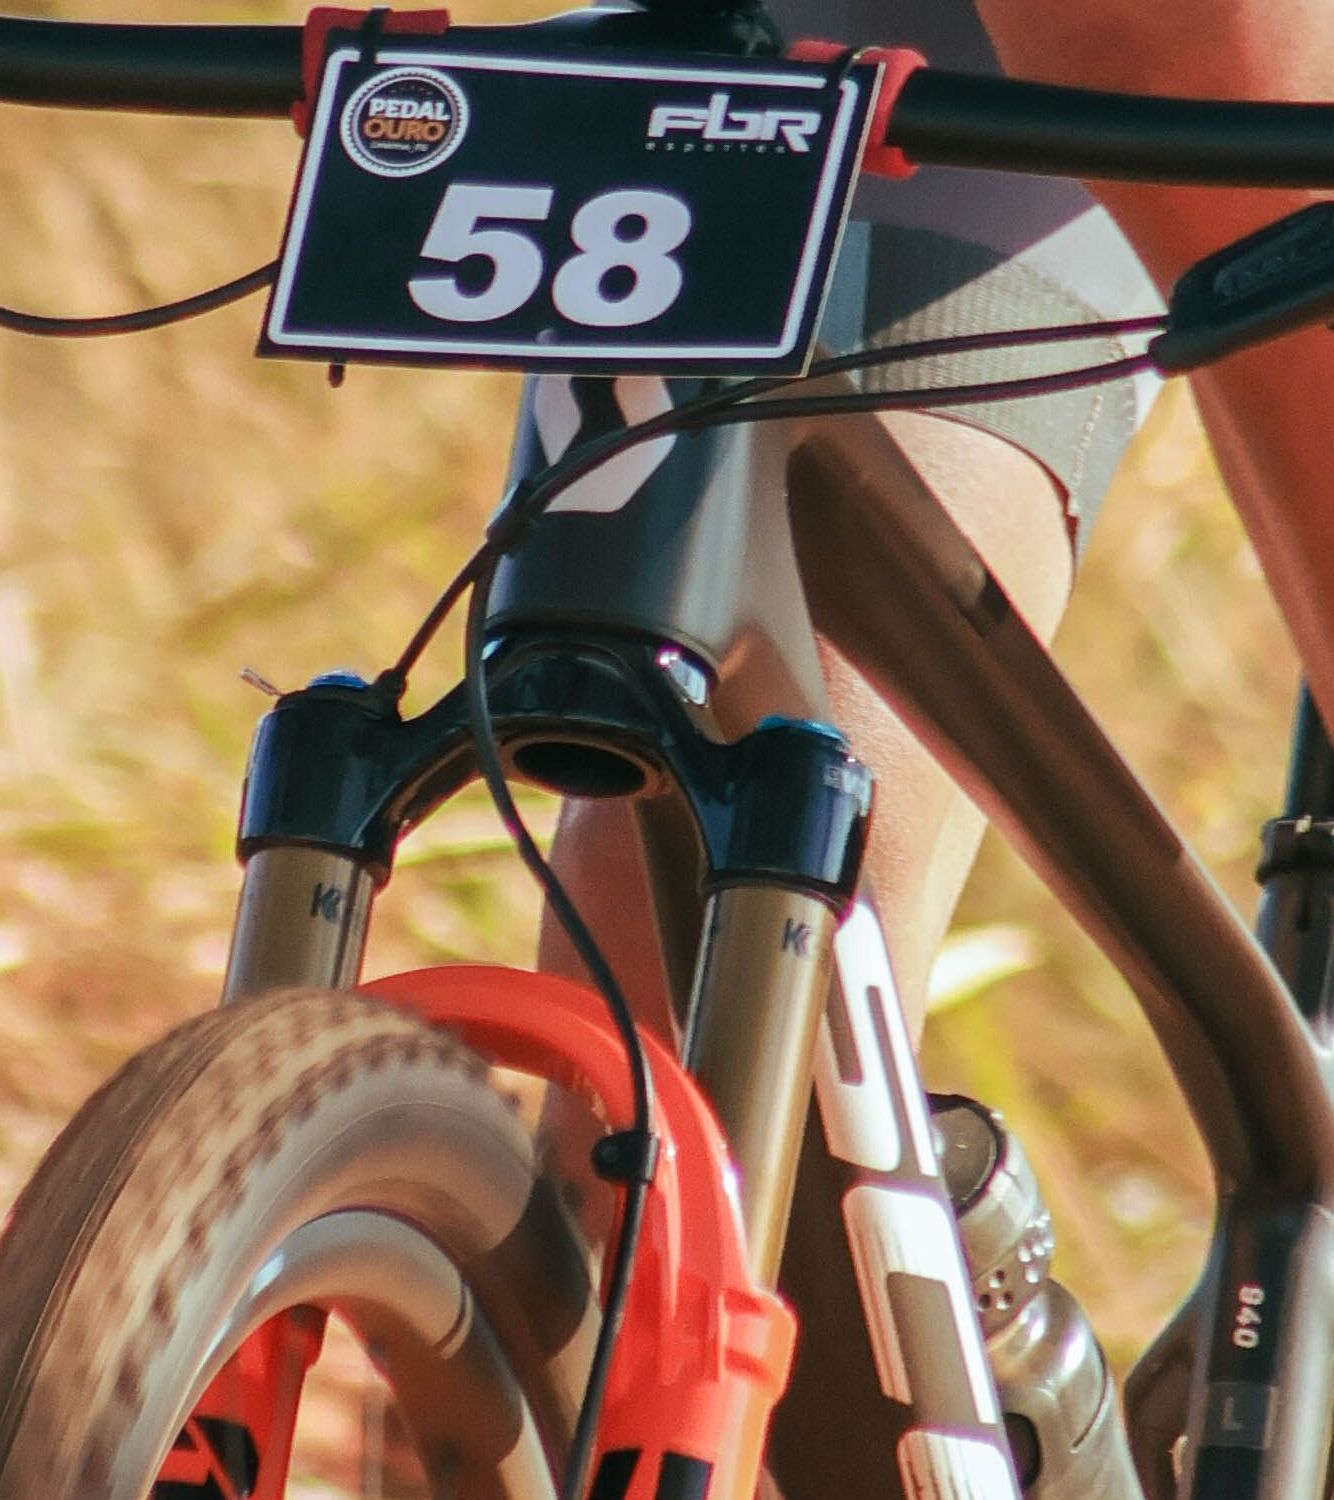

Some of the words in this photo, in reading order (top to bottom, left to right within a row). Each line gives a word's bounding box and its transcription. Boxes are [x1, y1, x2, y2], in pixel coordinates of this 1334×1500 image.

[368, 97, 452, 122] PEDAL
[363, 117, 446, 142] OURO
[407, 184, 692, 327] 58
